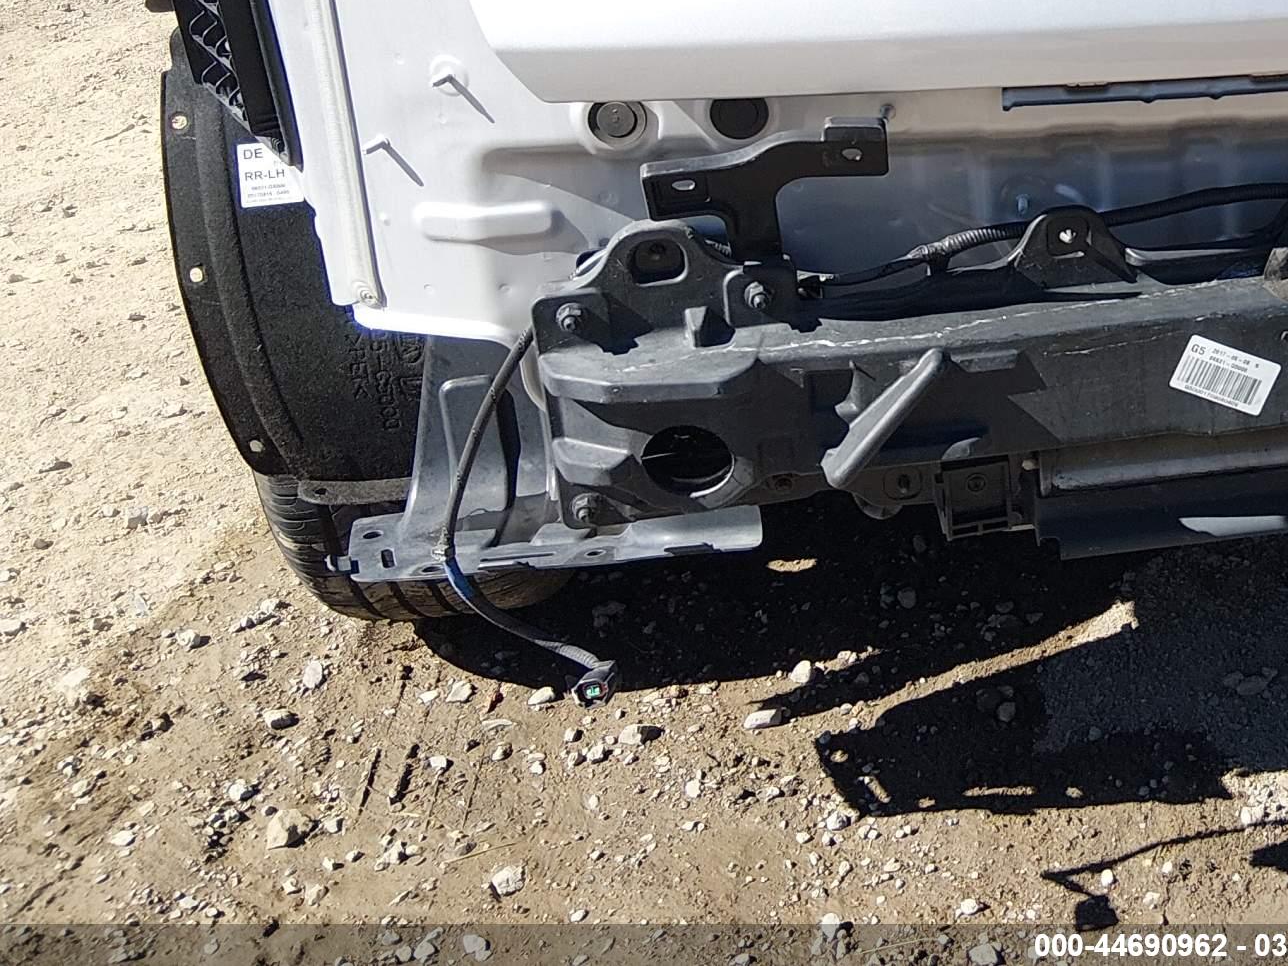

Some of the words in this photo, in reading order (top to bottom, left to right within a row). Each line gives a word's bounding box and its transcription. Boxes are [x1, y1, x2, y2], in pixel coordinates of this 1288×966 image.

[243, 148, 263, 160] DE
[244, 169, 285, 181] RR-LH
[1191, 343, 1206, 356] G5
